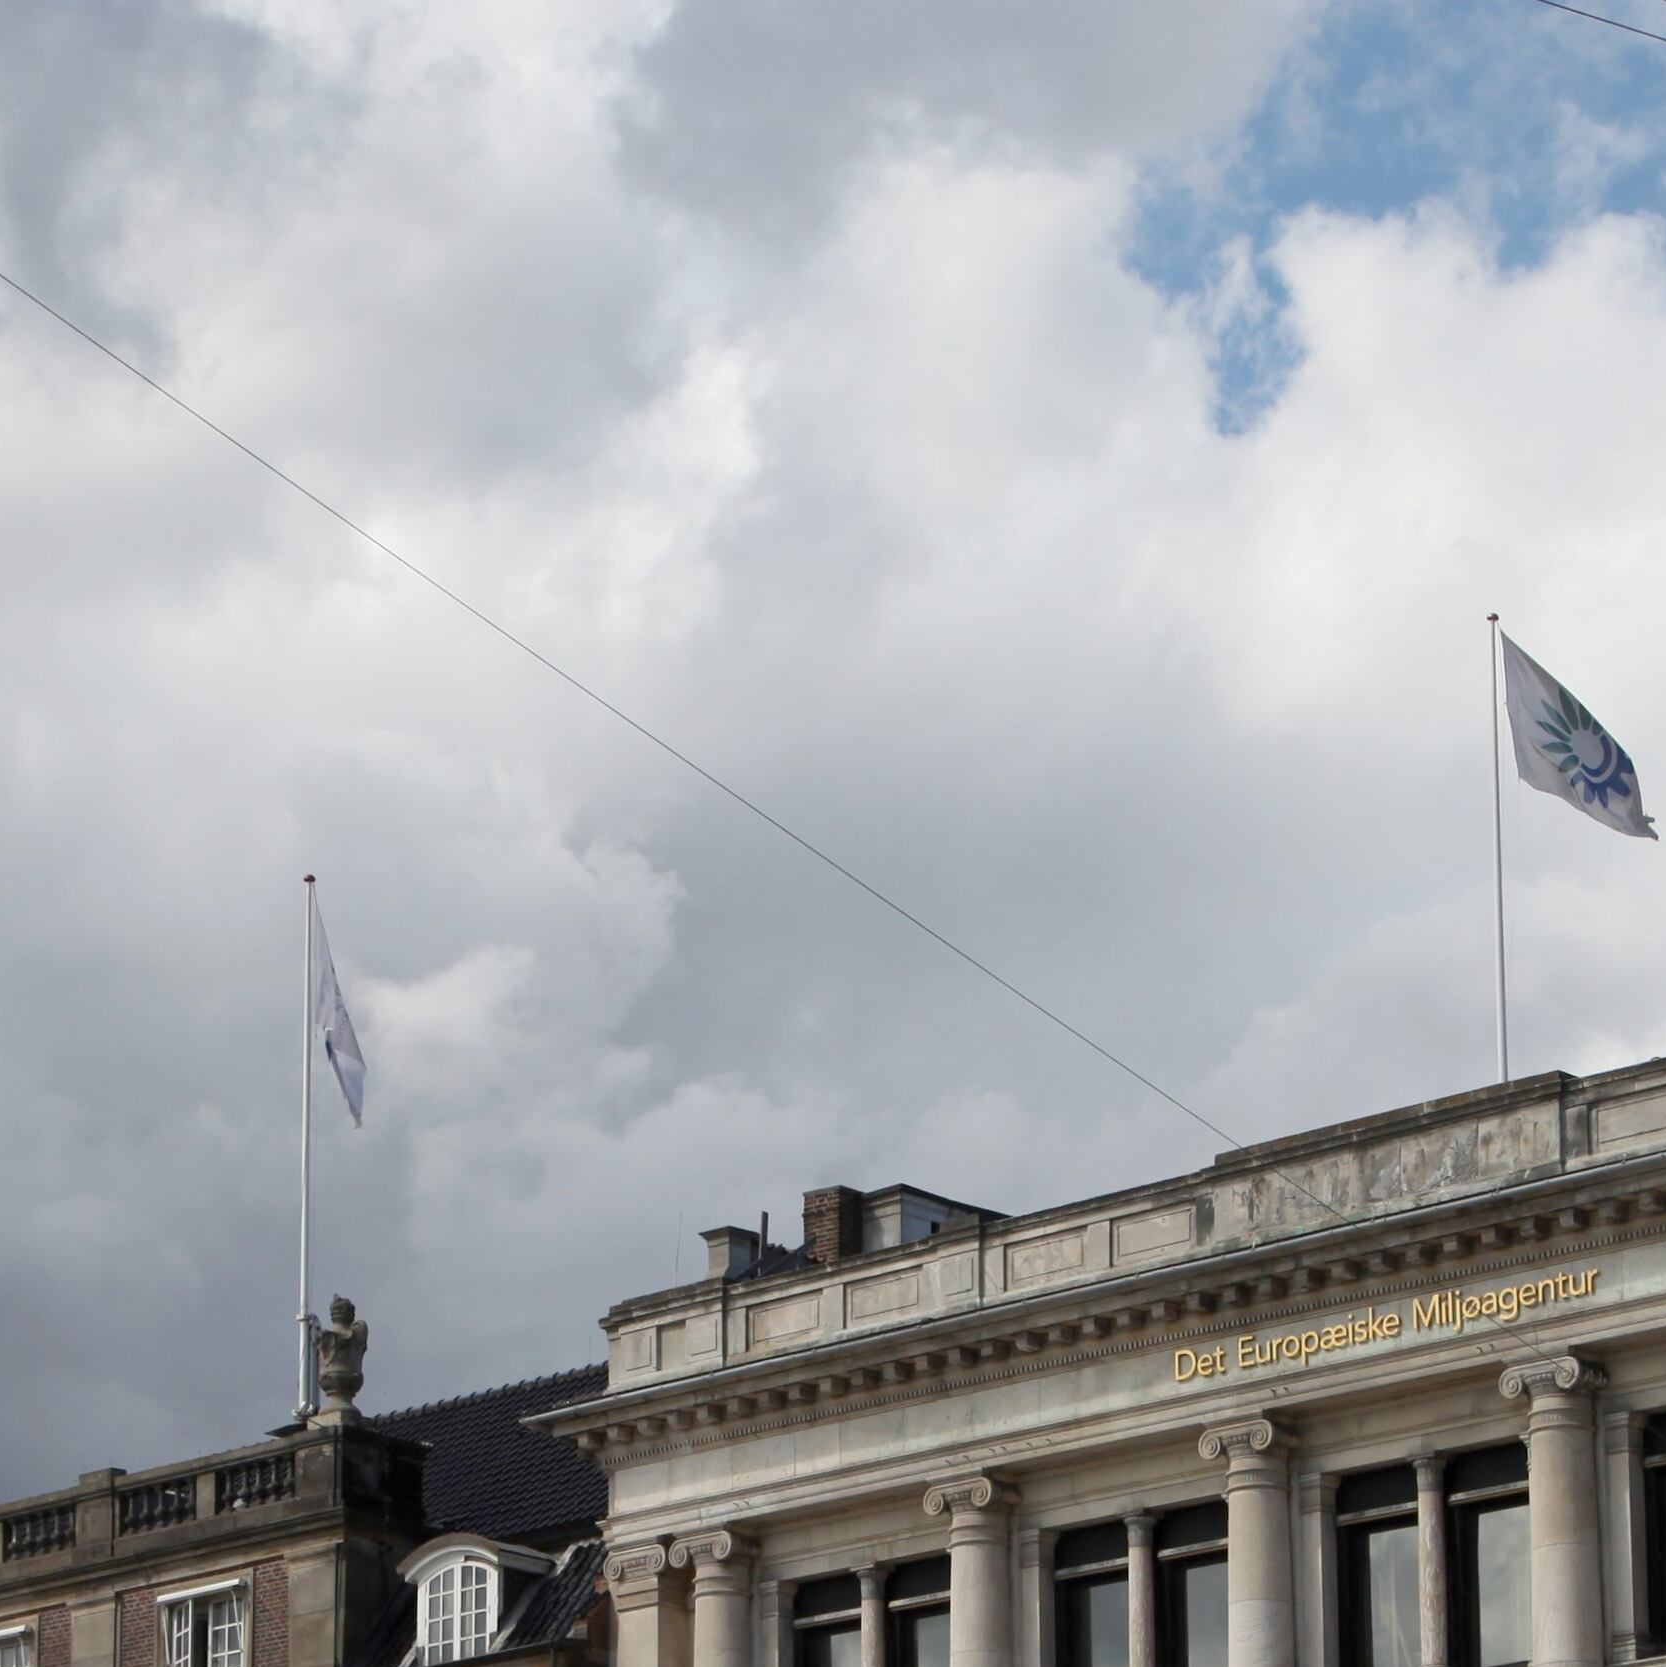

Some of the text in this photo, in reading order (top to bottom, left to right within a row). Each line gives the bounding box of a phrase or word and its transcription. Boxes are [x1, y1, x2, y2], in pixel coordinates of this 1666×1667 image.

[1174, 1269, 1599, 1382] Det Europæiske Miljøagentur
